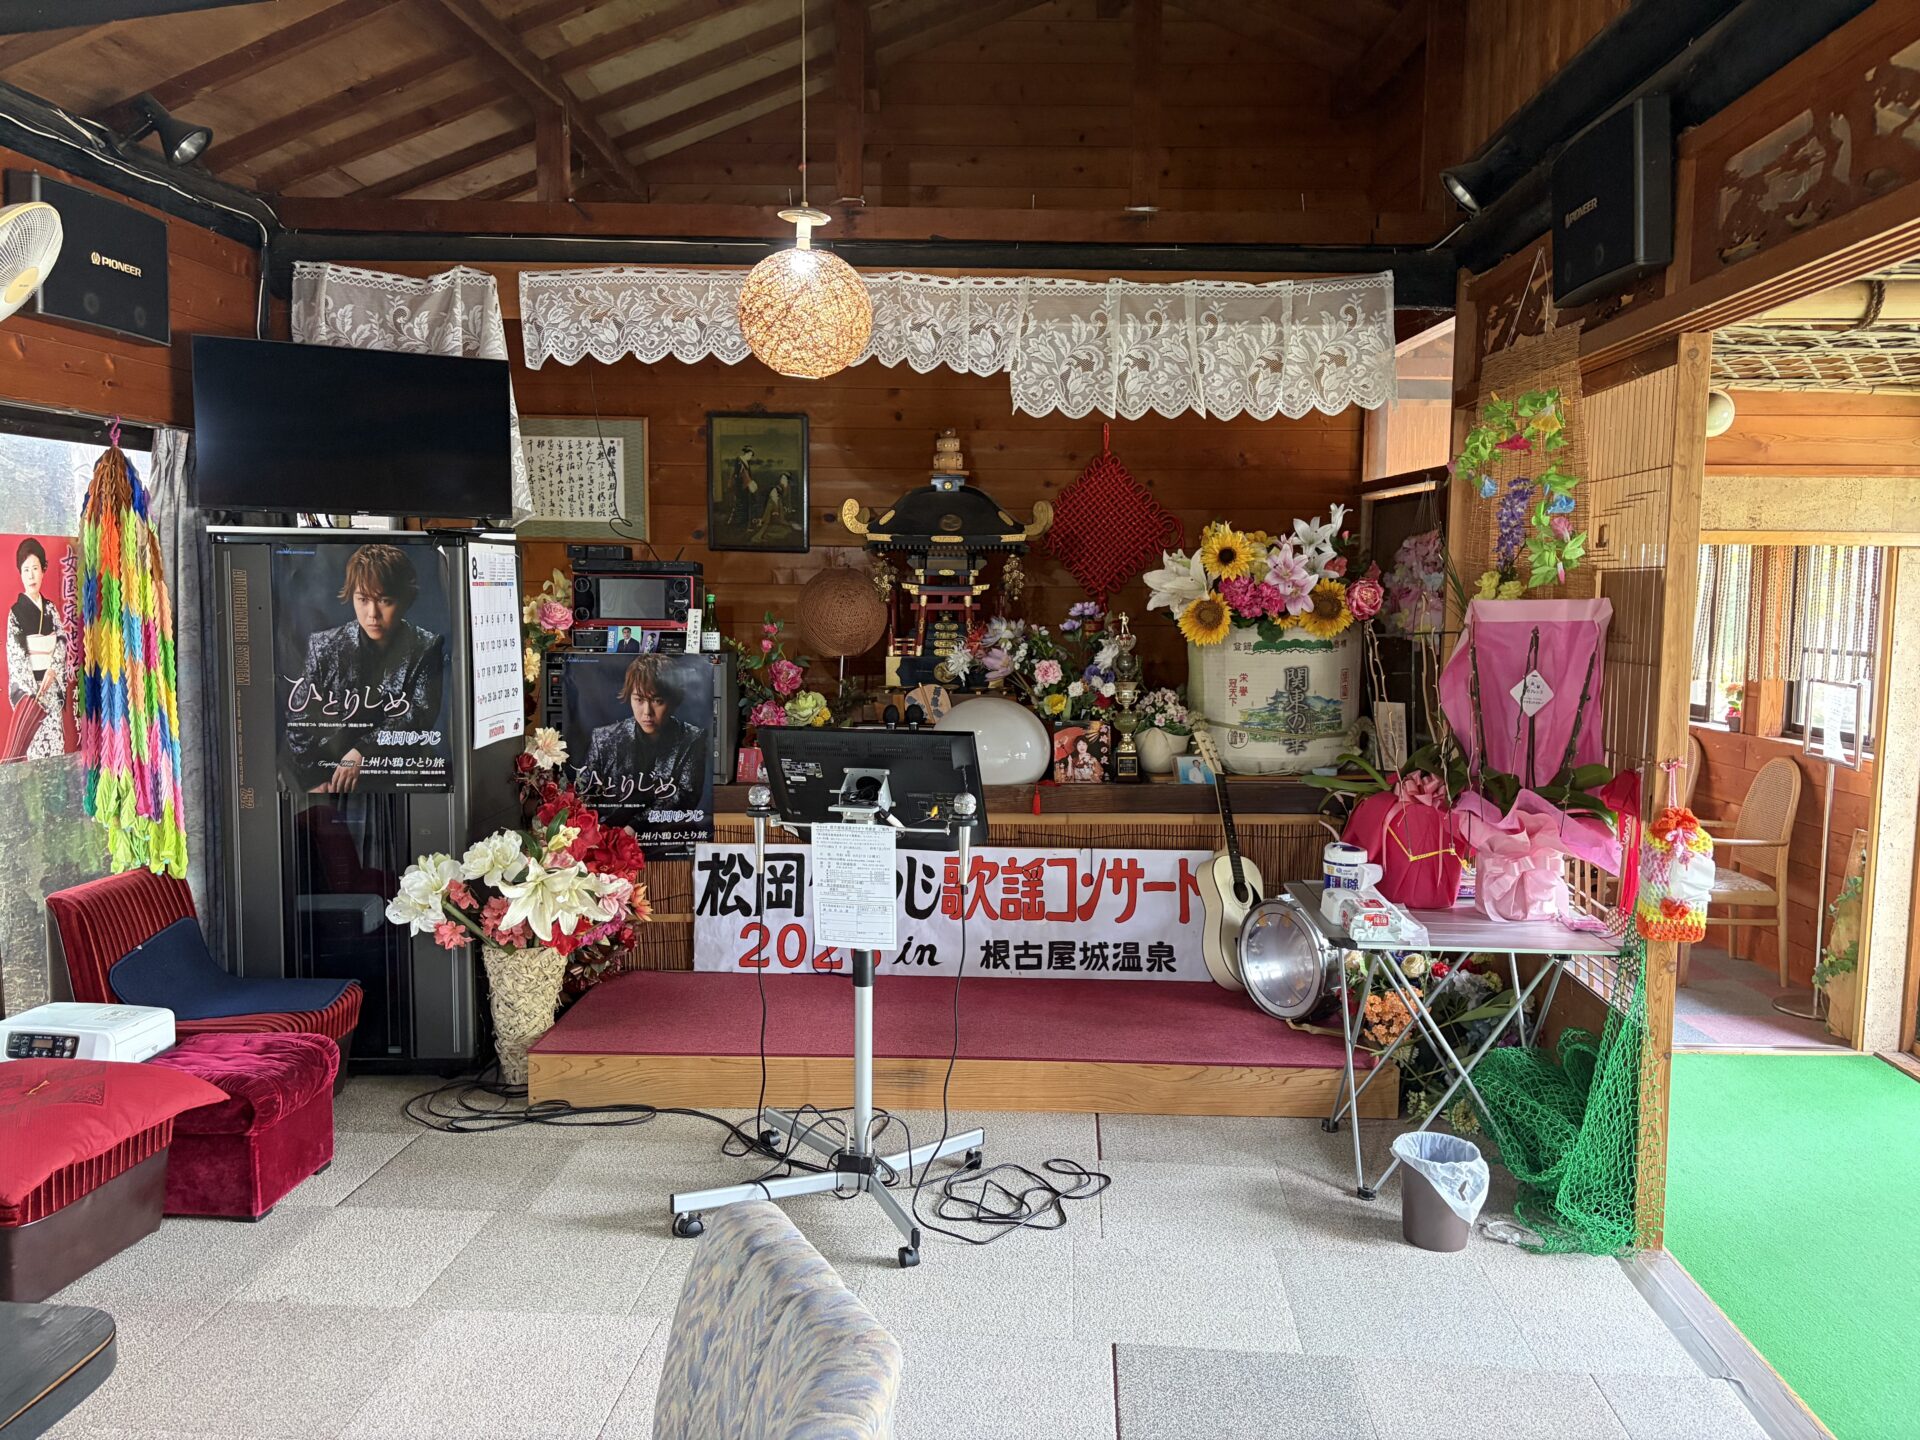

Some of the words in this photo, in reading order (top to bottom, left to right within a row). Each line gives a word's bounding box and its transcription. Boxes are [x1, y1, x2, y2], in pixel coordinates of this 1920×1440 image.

[1569, 197, 1598, 224] PIONEER
[101, 255, 142, 278] PIONEER
[472, 556, 478, 580] 8
[232, 568, 249, 643] AUTOCHANGER
[235, 645, 251, 686] SYSTEM
[283, 674, 411, 721] ひとりじめ
[376, 730, 442, 746] 松岡ゆうじ
[405, 756, 445, 768] ひとり旅
[569, 763, 678, 803] ひとりじめ
[240, 787, 255, 809] 252
[647, 809, 705, 823] 松岡ゆうじ
[739, 922, 882, 970] 202
[892, 936, 942, 967] in
[980, 940, 1177, 973] 根古屋城温泉
